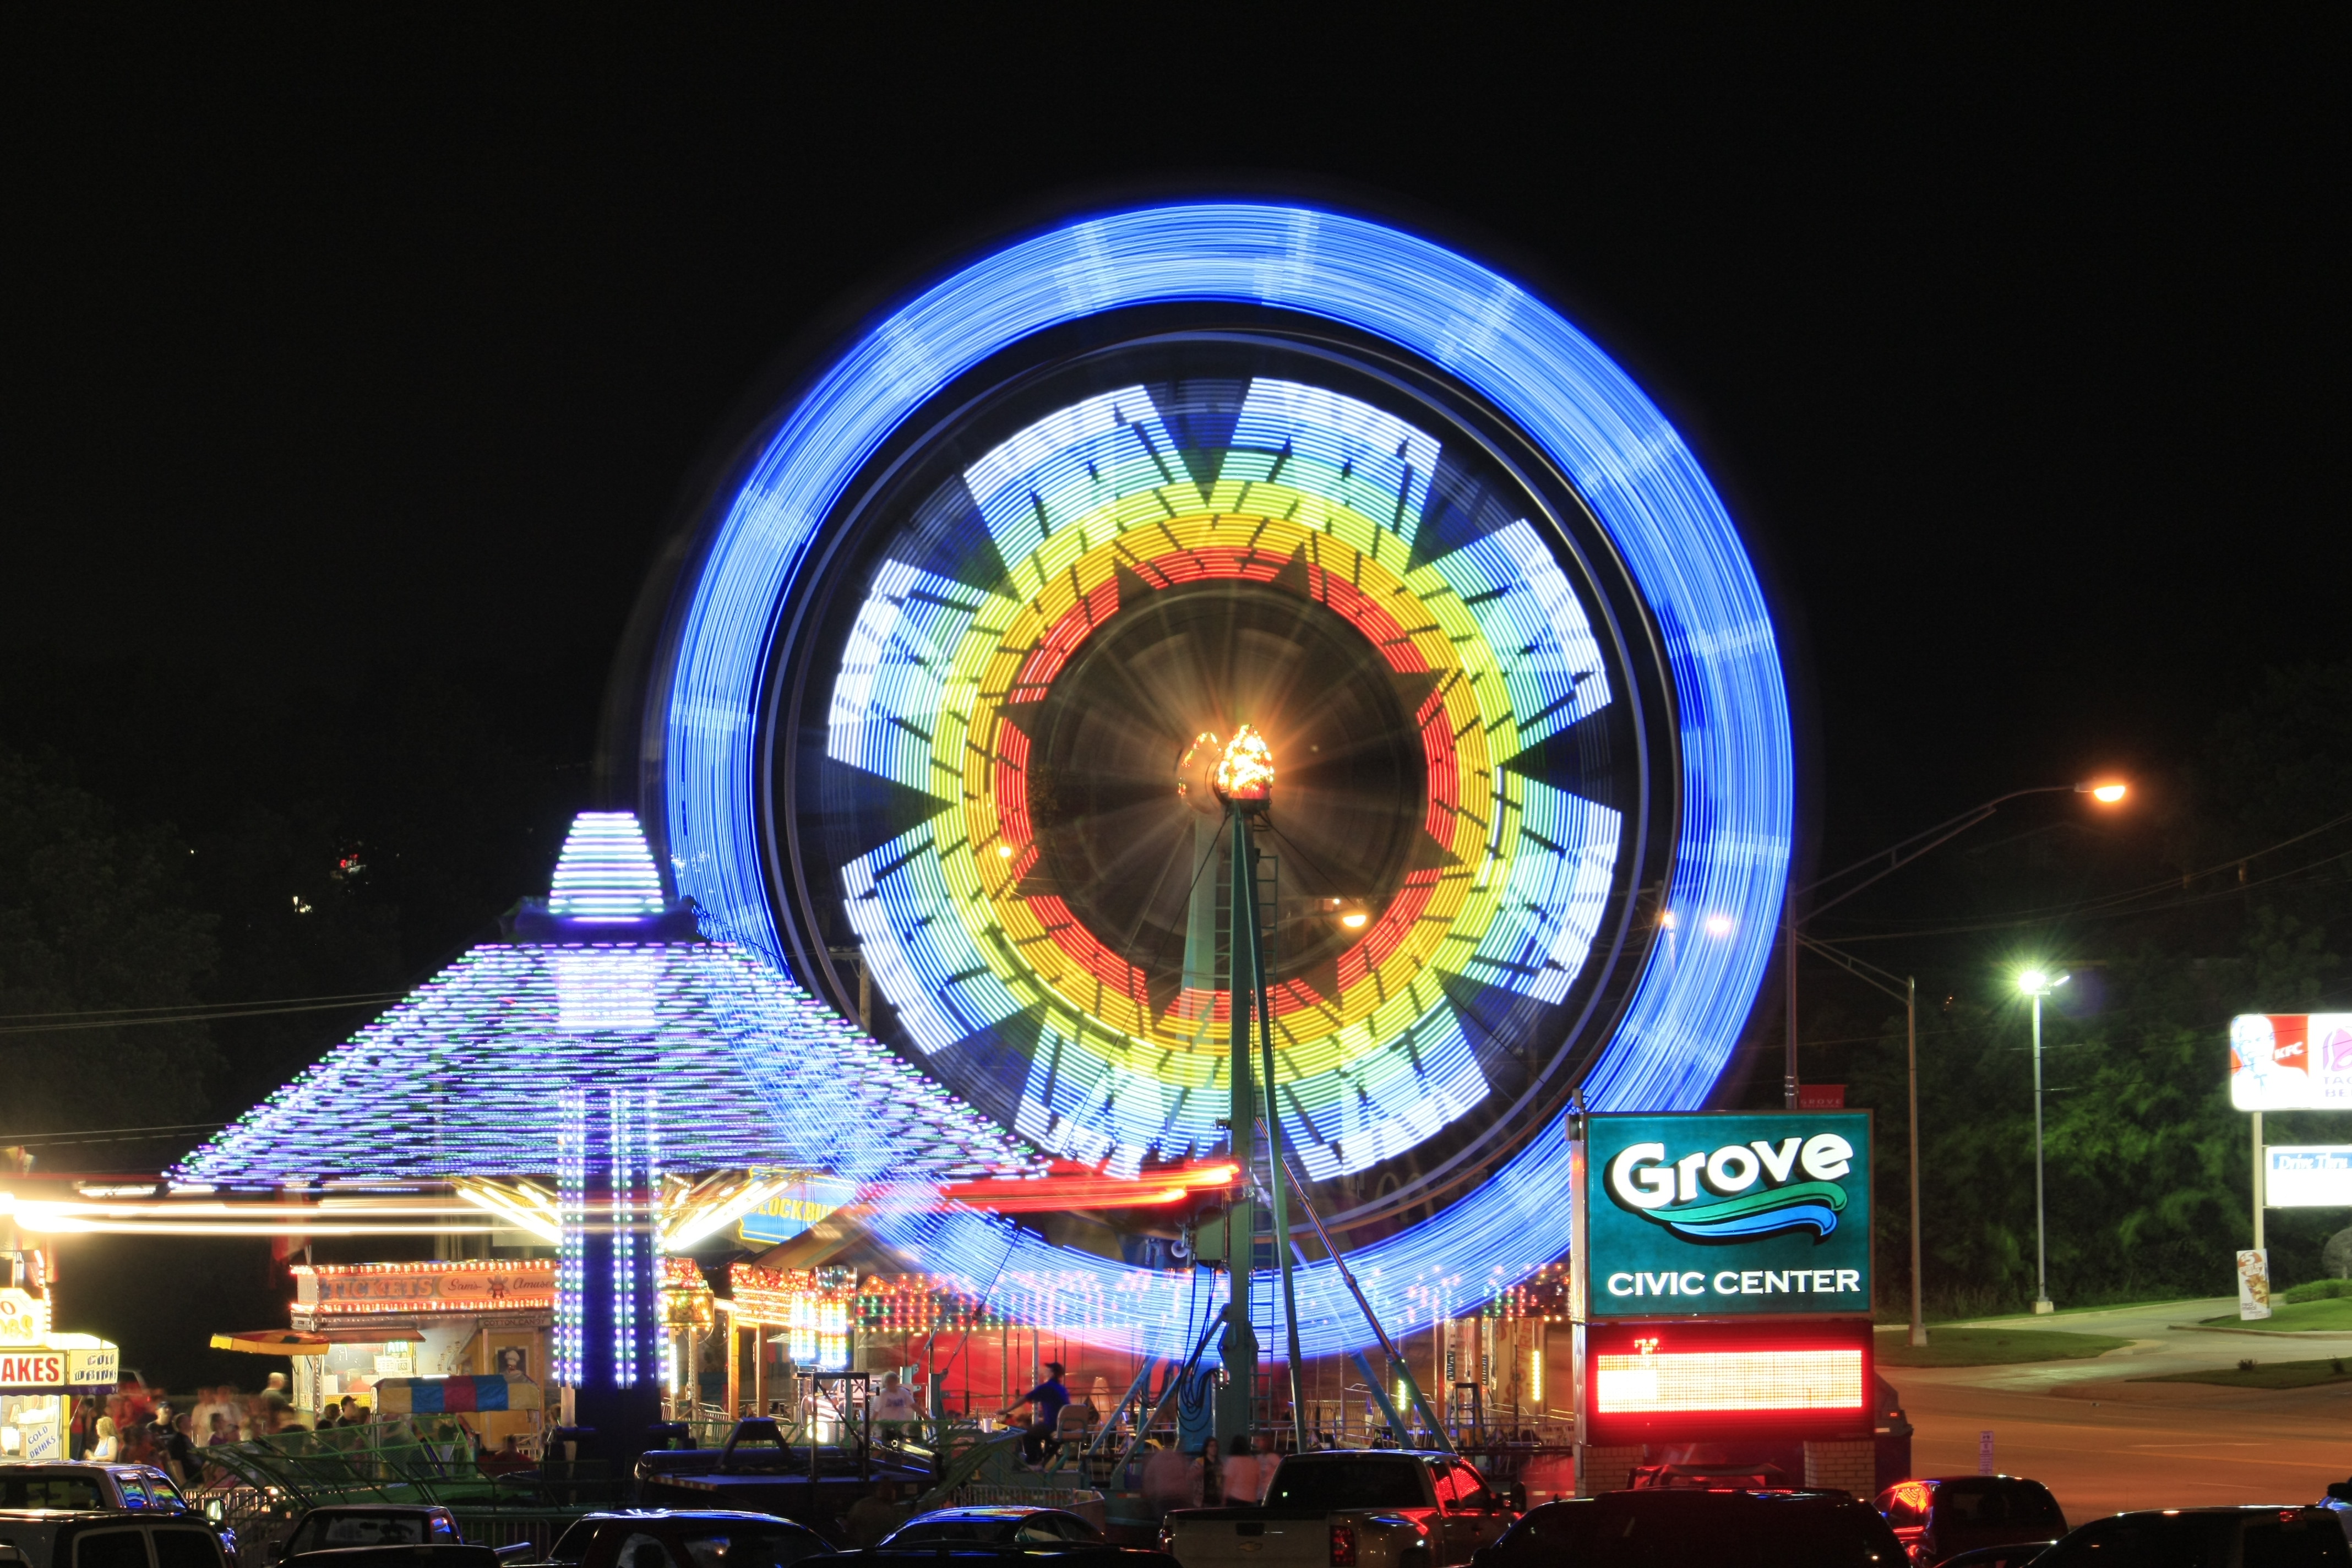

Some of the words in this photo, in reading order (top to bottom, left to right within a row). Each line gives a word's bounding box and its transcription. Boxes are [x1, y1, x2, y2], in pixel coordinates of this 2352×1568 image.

[2274, 1041, 2304, 1060] KFC
[2325, 1088, 2352, 1097] BE
[2278, 1153, 2314, 1170] Drive
[2315, 1152, 2348, 1169] Thru
[1611, 1133, 1854, 1210] Grove
[325, 1278, 433, 1299] TICKETS
[447, 1278, 482, 1291] Sam's
[1607, 1271, 1706, 1297] CIVIC
[1713, 1269, 1861, 1295] CENTER
[388, 1341, 408, 1353] ATM
[87, 1353, 115, 1366] COLD
[2, 1357, 59, 1382] AKES
[28, 1425, 48, 1444] COLD
[29, 1435, 56, 1458] DRINKS
